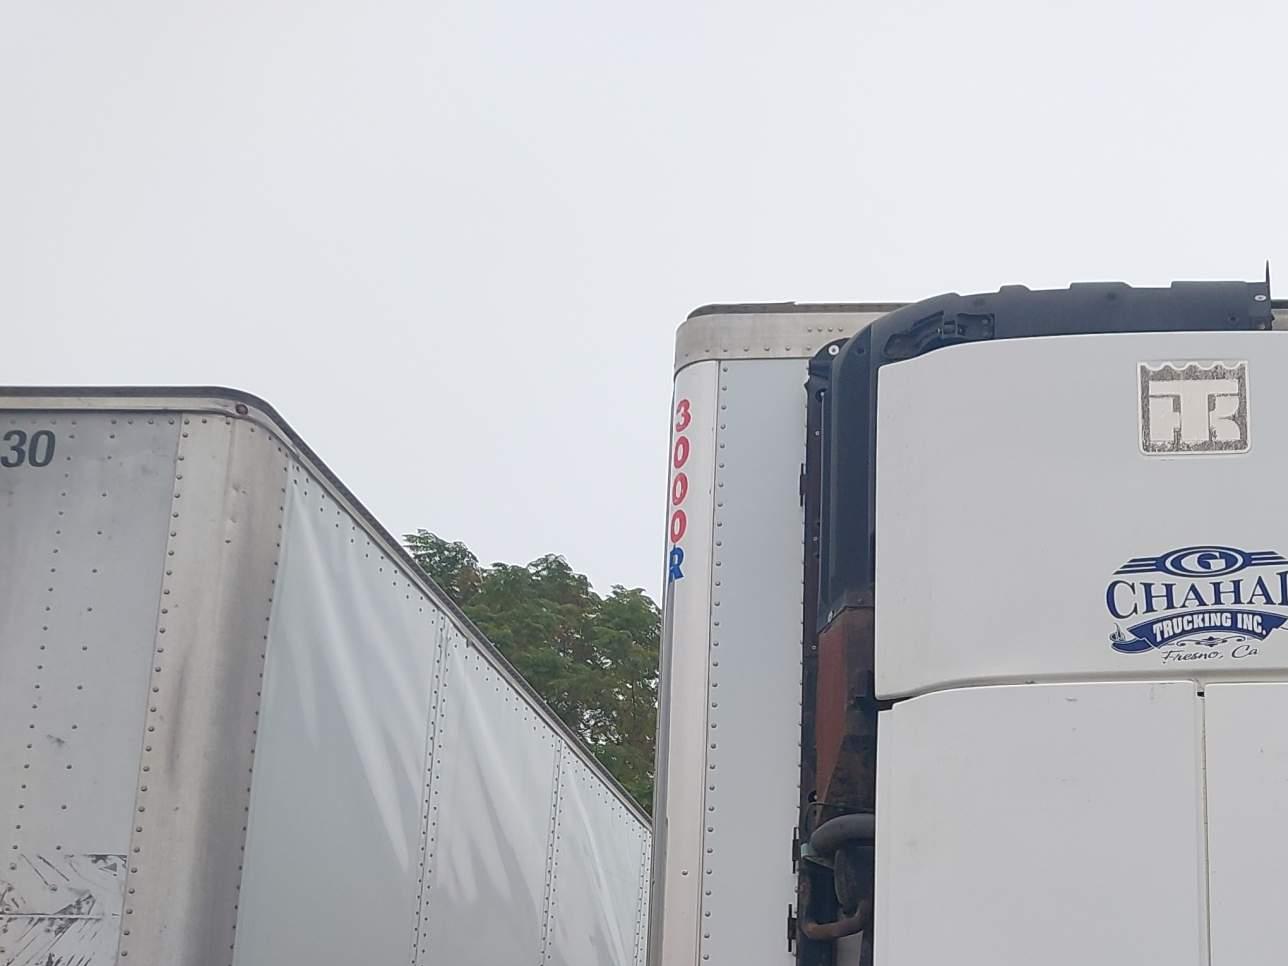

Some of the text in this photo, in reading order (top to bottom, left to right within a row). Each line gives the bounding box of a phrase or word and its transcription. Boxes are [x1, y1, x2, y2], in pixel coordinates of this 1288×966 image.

[0, 430, 56, 468] 30
[1152, 612, 1268, 643] TRUCKING INC.
[1161, 644, 1259, 664] Fresno, Ca
